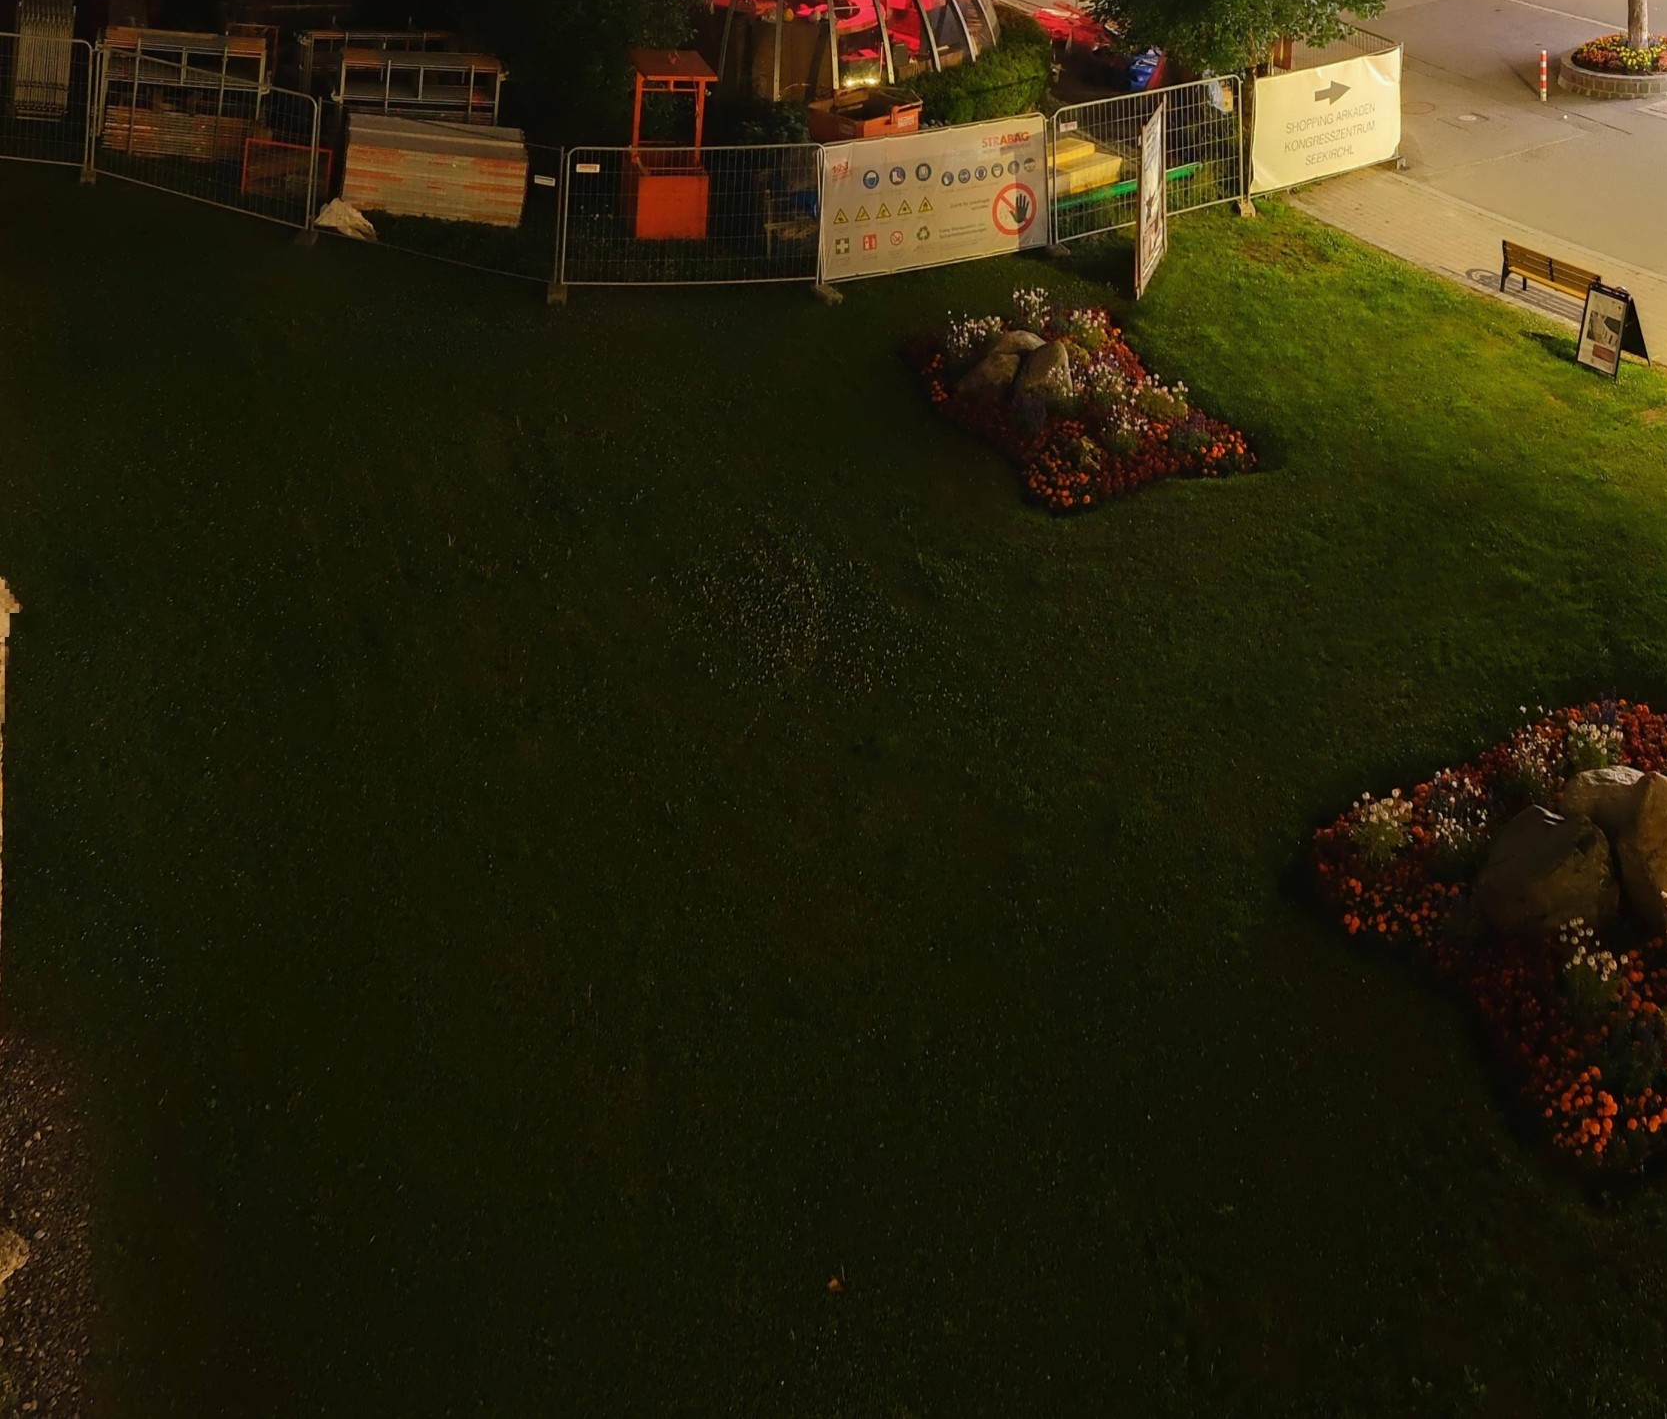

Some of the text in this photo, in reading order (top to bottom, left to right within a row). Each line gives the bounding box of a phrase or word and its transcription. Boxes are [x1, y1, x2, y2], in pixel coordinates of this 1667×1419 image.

[1286, 102, 1376, 134] SHOPPING ARKADEN
[982, 132, 1030, 149] STRABAG
[1284, 120, 1376, 153] KONGRESSZENTRUM
[1305, 145, 1355, 166] SEEKIRCHL
